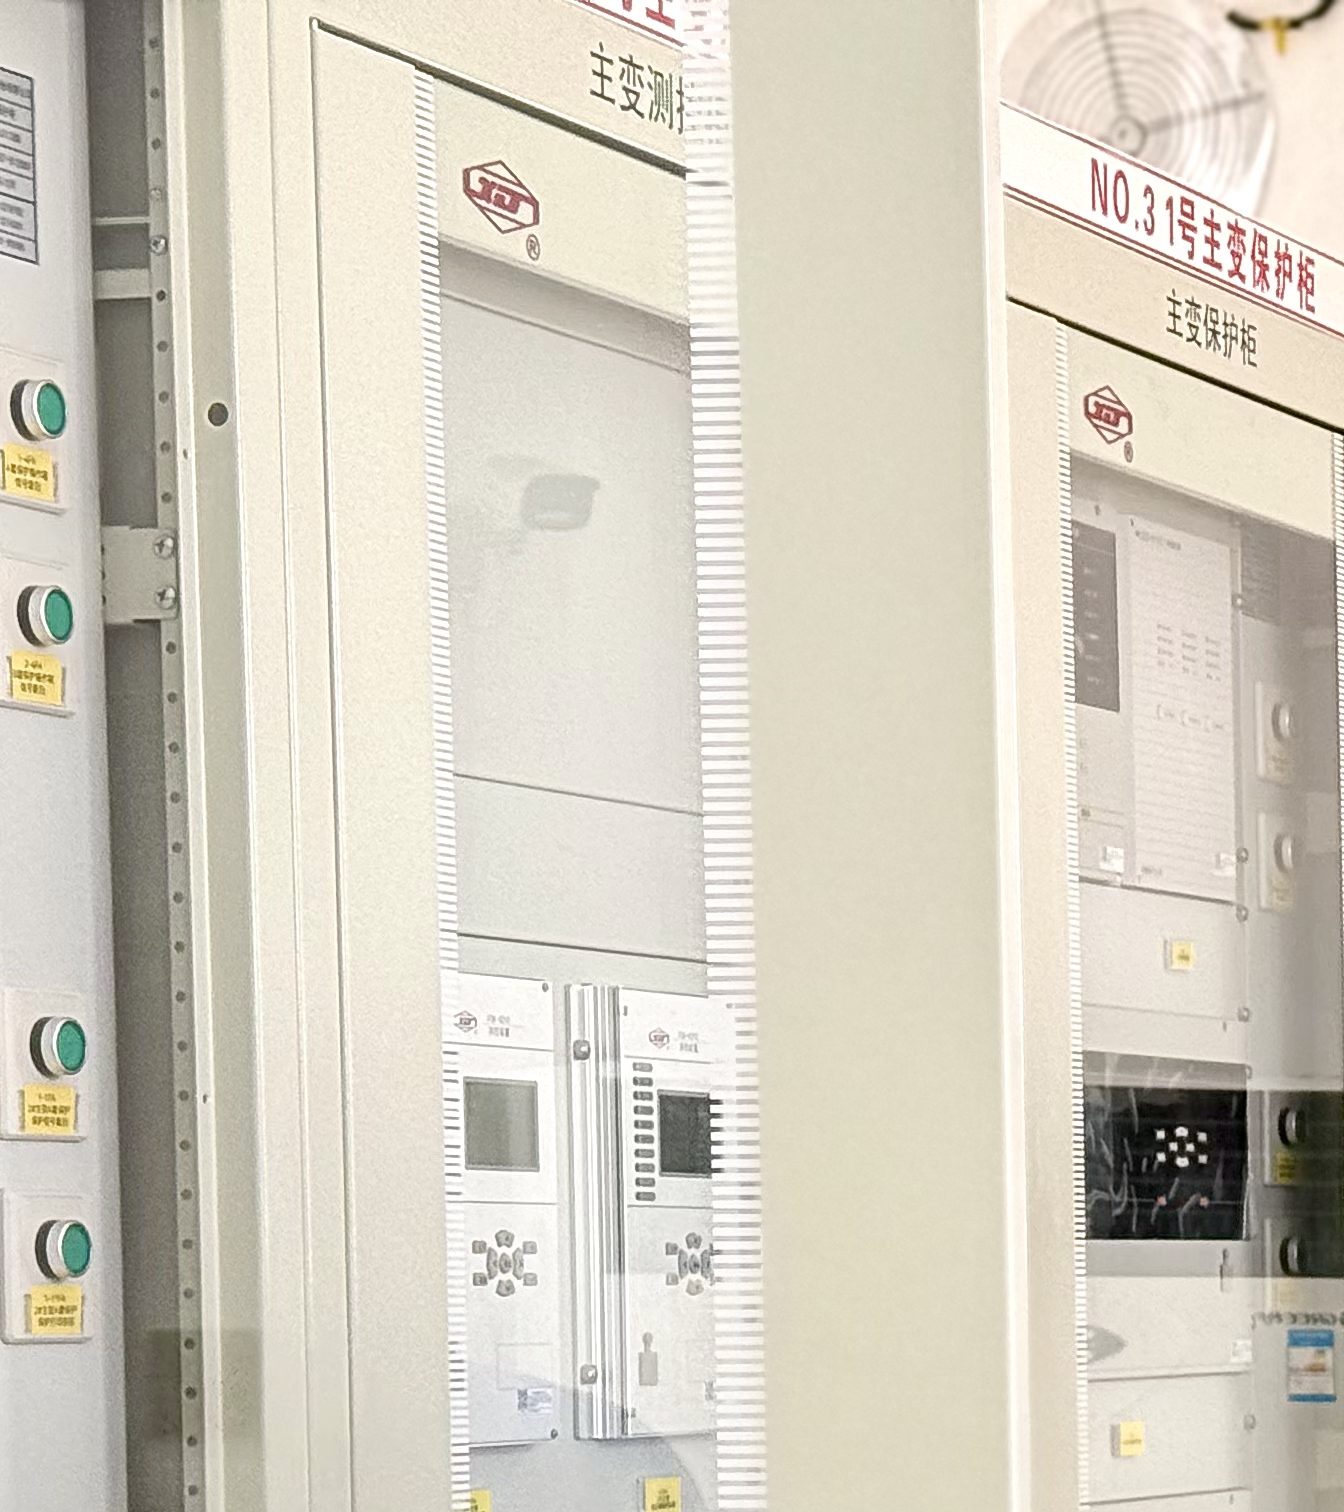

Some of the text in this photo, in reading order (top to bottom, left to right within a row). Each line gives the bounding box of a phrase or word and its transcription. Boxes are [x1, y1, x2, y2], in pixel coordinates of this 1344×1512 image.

[1165, 287, 1258, 369] 主变保护柜
